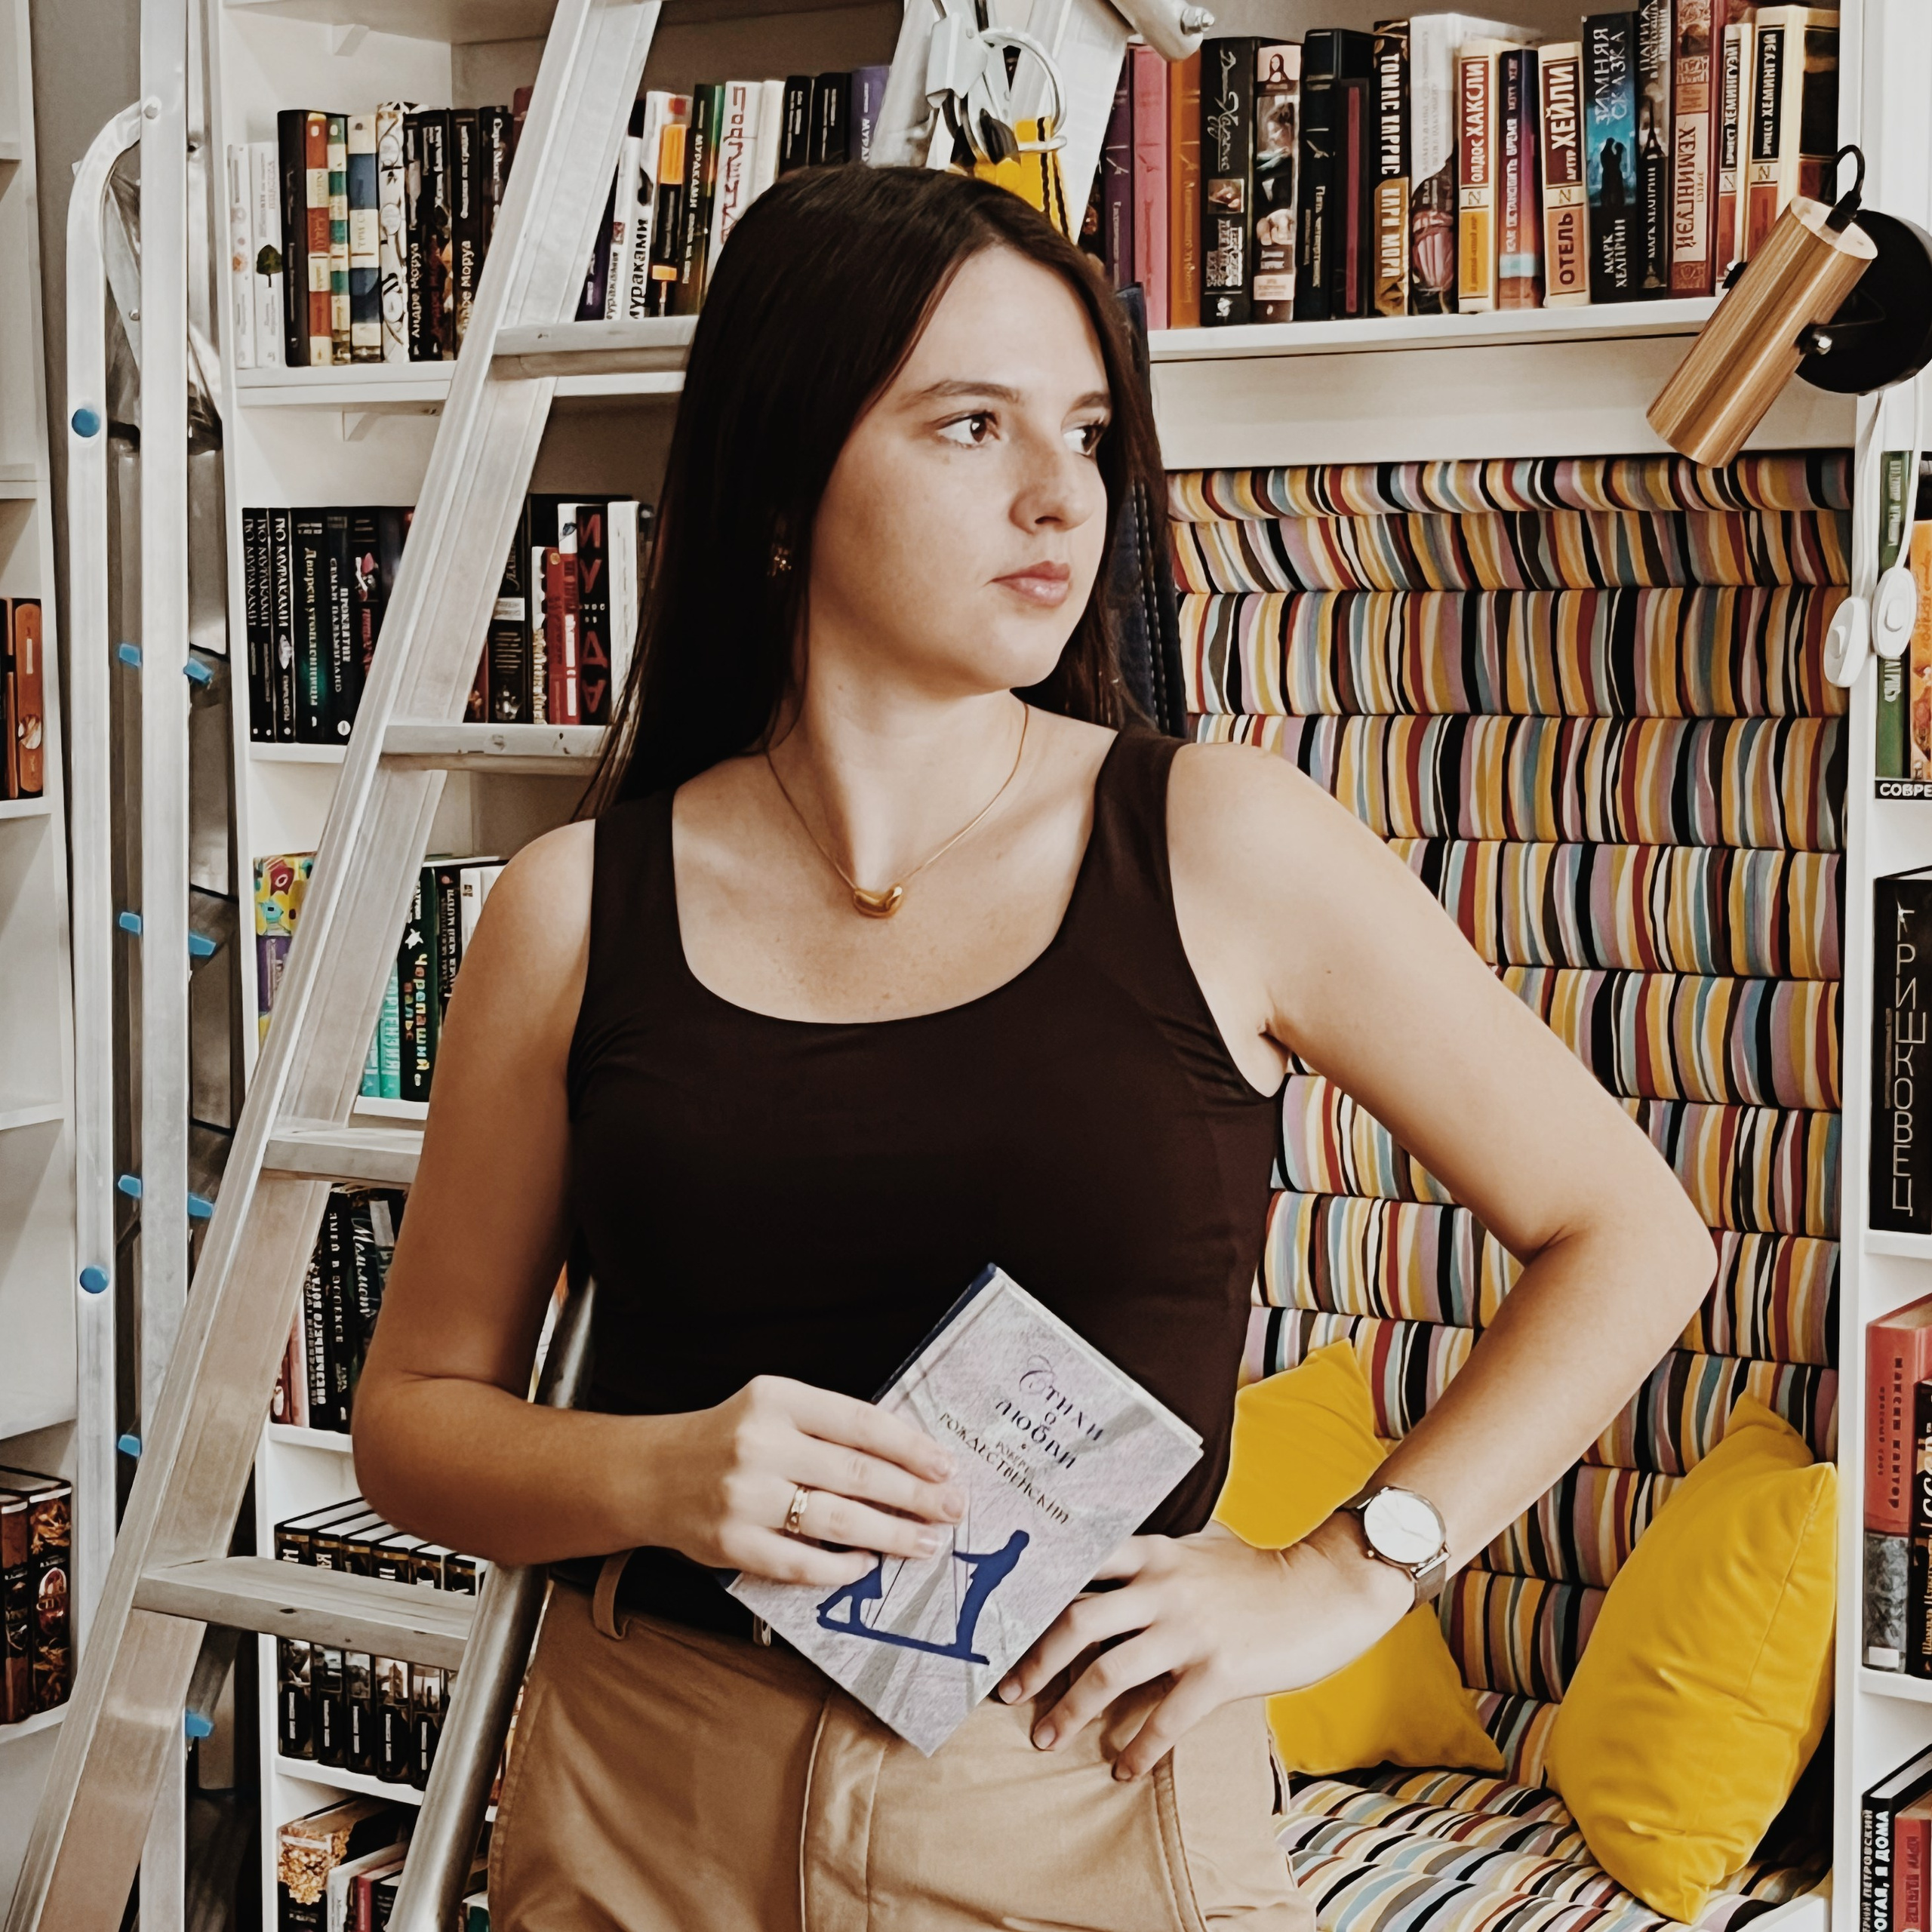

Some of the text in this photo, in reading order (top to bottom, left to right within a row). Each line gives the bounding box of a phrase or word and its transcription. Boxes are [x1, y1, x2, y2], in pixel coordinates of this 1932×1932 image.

[1380, 54, 1401, 175] ТОМАС ХАРРИС
[1545, 65, 1577, 150] ХЕЙЛИ
[1592, 28, 1610, 124] ЗИМНЯЯ
[1609, 30, 1628, 120] СКАЗКА
[1761, 33, 1777, 117] ХЕМИНГУЭЙ
[1465, 63, 1485, 183] ОЛДОС ХАКСЛИ
[1675, 126, 1697, 251] ХЕМИНГУЭЙ
[1381, 234, 1401, 278] МОРА
[1557, 212, 1576, 285] ОТЕЛЬ
[1602, 234, 1615, 273] МАРК
[303, 548, 318, 604] Дворец
[1892, 908, 1928, 1217] ГРИШКОВЕЦ
[1874, 1810, 1890, 1863] ДОМА
[1873, 1882, 1890, 1932] ОГАЯ,
